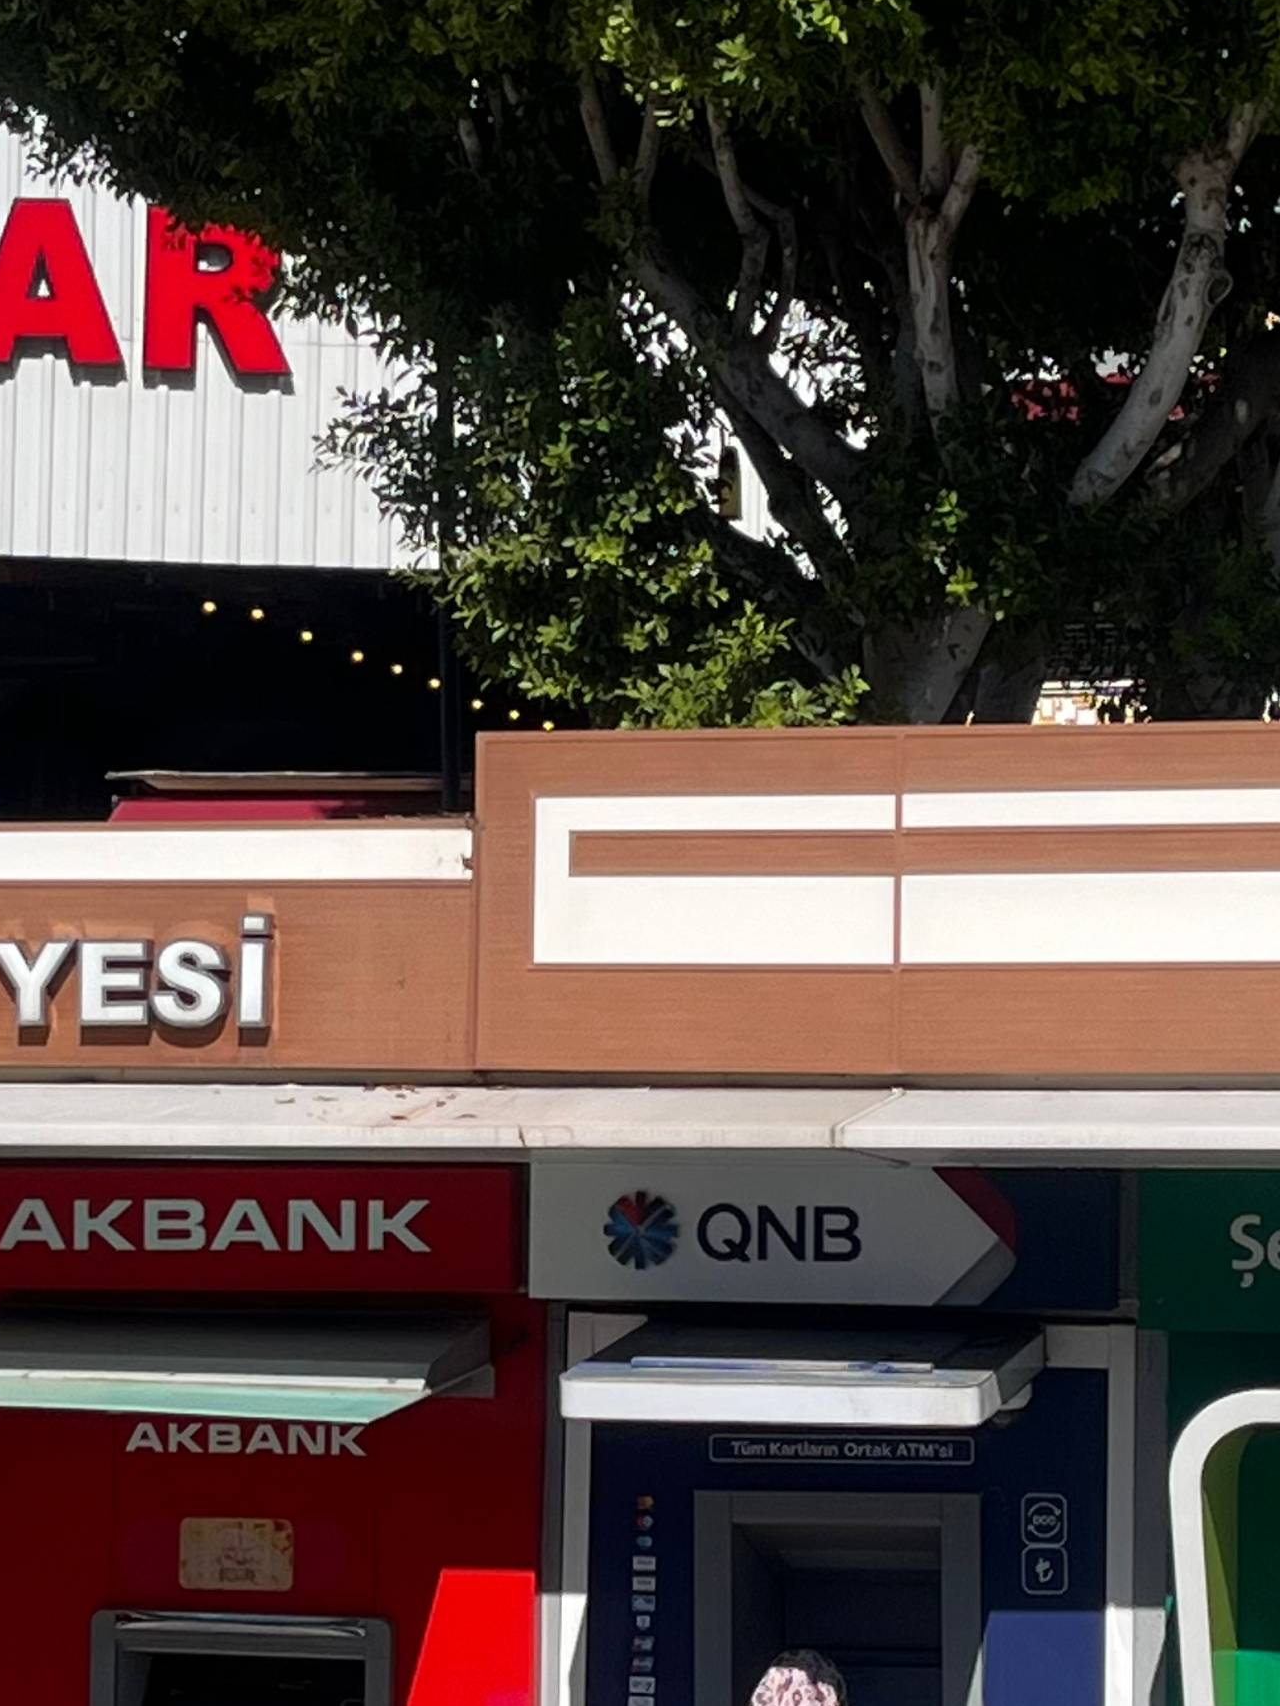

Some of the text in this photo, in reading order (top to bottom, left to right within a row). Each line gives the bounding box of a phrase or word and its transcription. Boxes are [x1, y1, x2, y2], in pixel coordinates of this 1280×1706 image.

[696, 1202, 862, 1262] QNB
[125, 1421, 368, 1457] AKBANK
[730, 1440, 766, 1456] Tüm
[843, 1442, 890, 1458] Ortak
